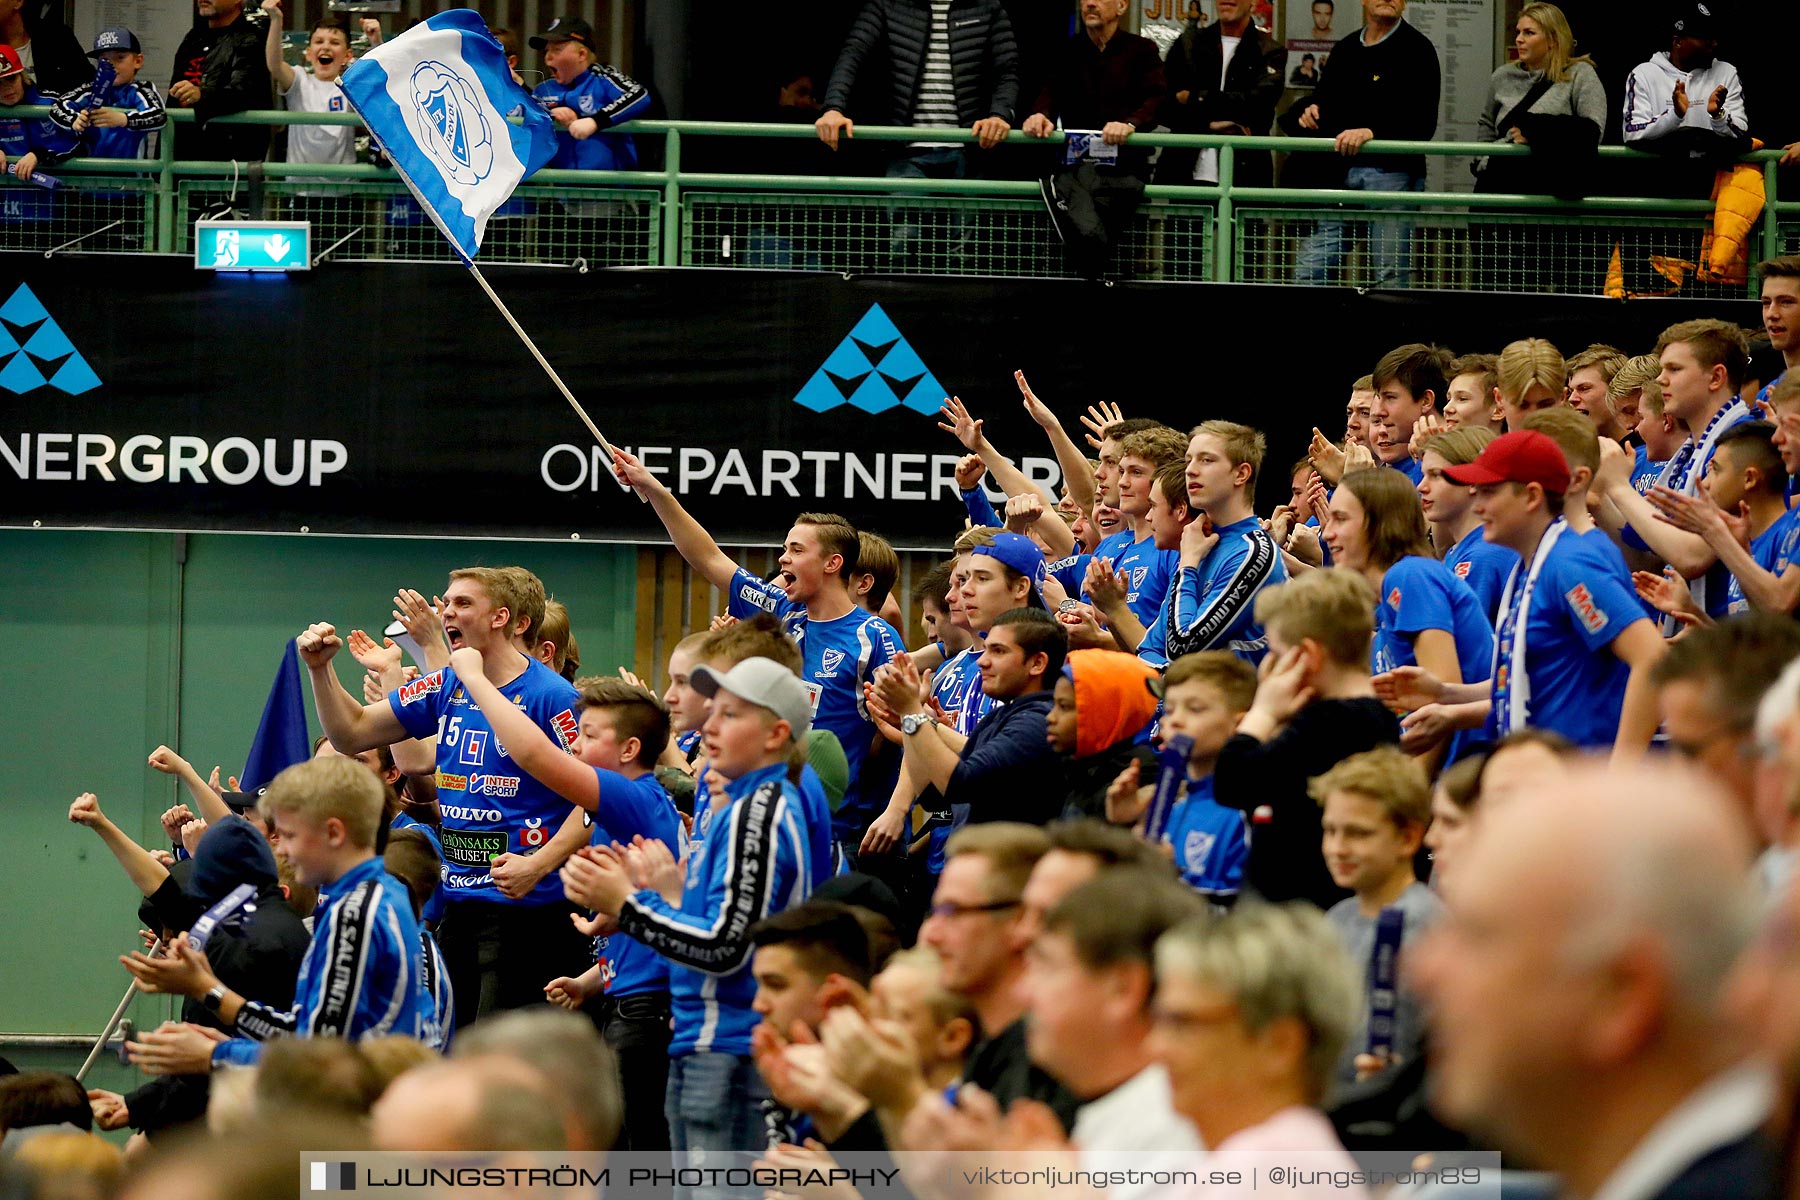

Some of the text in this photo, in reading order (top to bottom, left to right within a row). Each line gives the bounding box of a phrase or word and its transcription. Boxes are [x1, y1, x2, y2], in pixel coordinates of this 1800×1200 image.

[97, 37, 119, 47] YORK
[99, 31, 117, 41] NEW
[1571, 585, 1604, 629] MAXI
[399, 673, 443, 702] MAXI
[437, 714, 463, 747] 15
[486, 776, 518, 788] INTER
[485, 786, 517, 796] SPORT
[440, 804, 502, 822] VOLVO
[442, 833, 500, 850] GRÖNSAKS
[453, 848, 490, 862] HUSET
